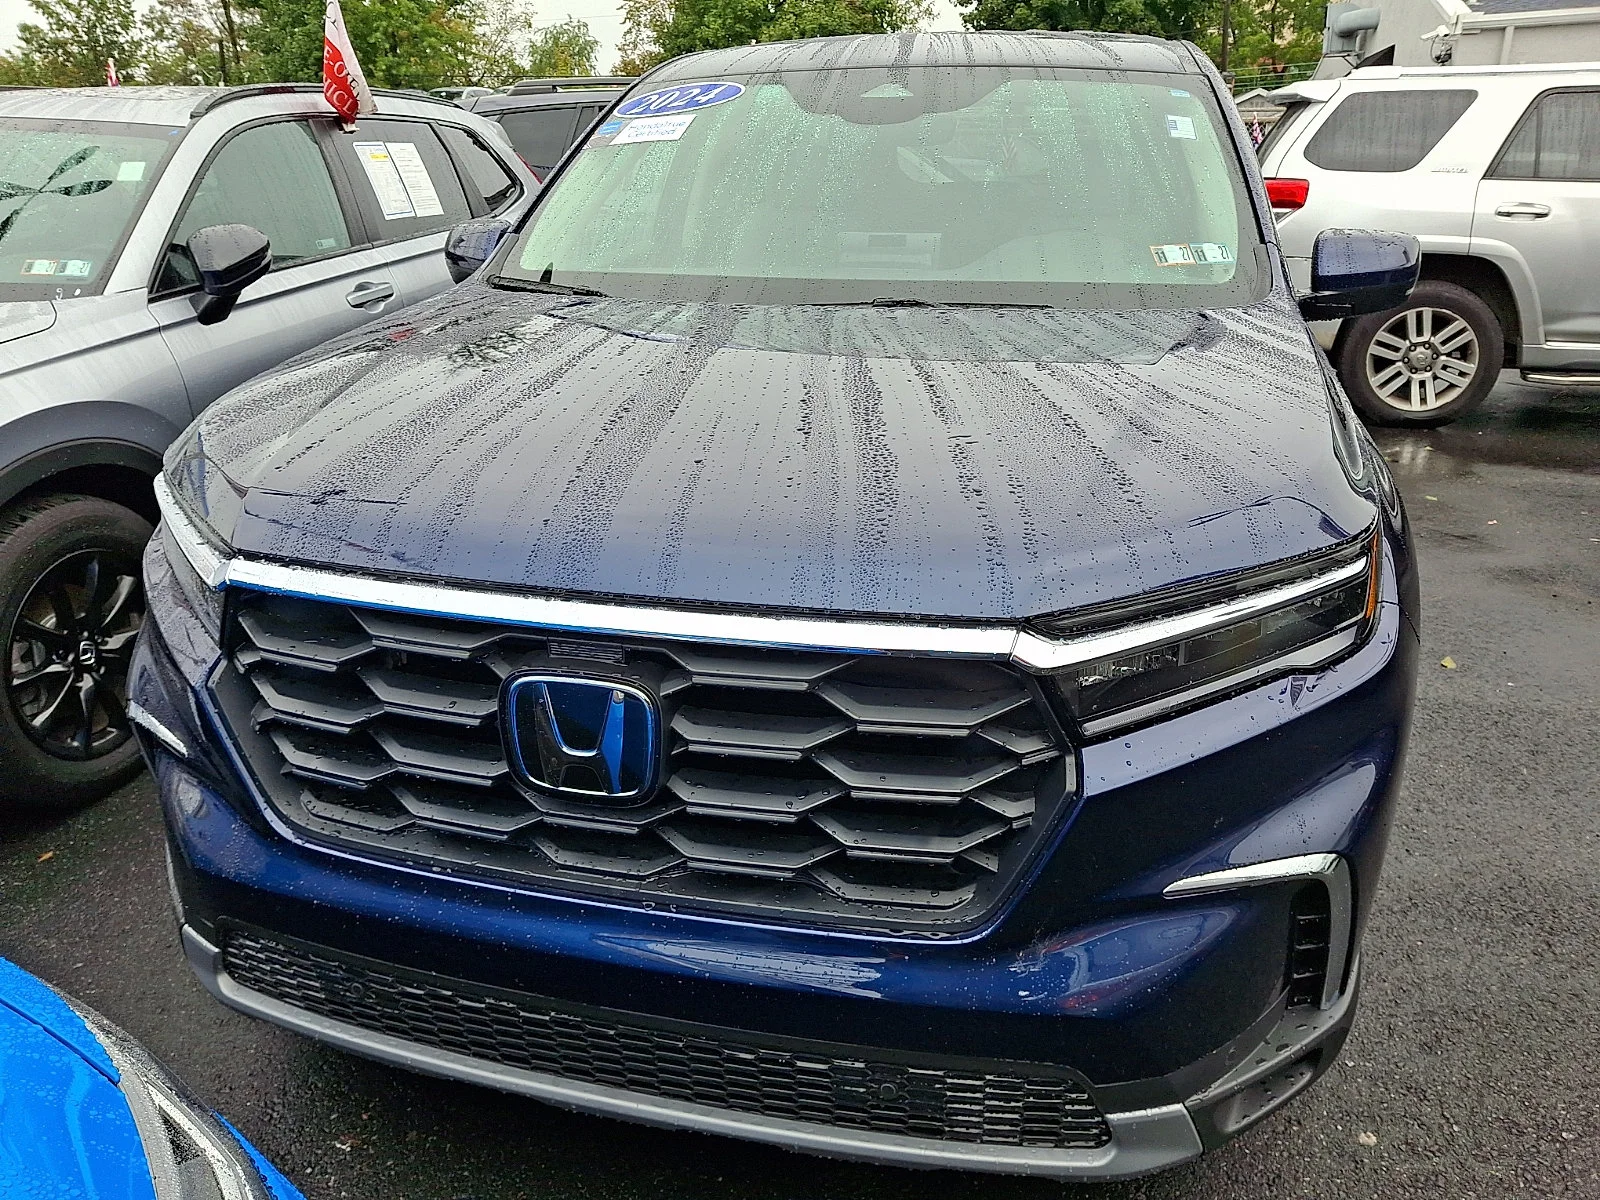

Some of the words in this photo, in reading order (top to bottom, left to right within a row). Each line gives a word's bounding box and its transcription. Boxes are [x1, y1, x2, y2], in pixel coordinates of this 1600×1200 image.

[626, 84, 729, 115] 2024
[1155, 250, 1168, 263] 11
[1179, 246, 1191, 260] 27
[1194, 249, 1208, 261] 11
[1217, 245, 1229, 259] 27
